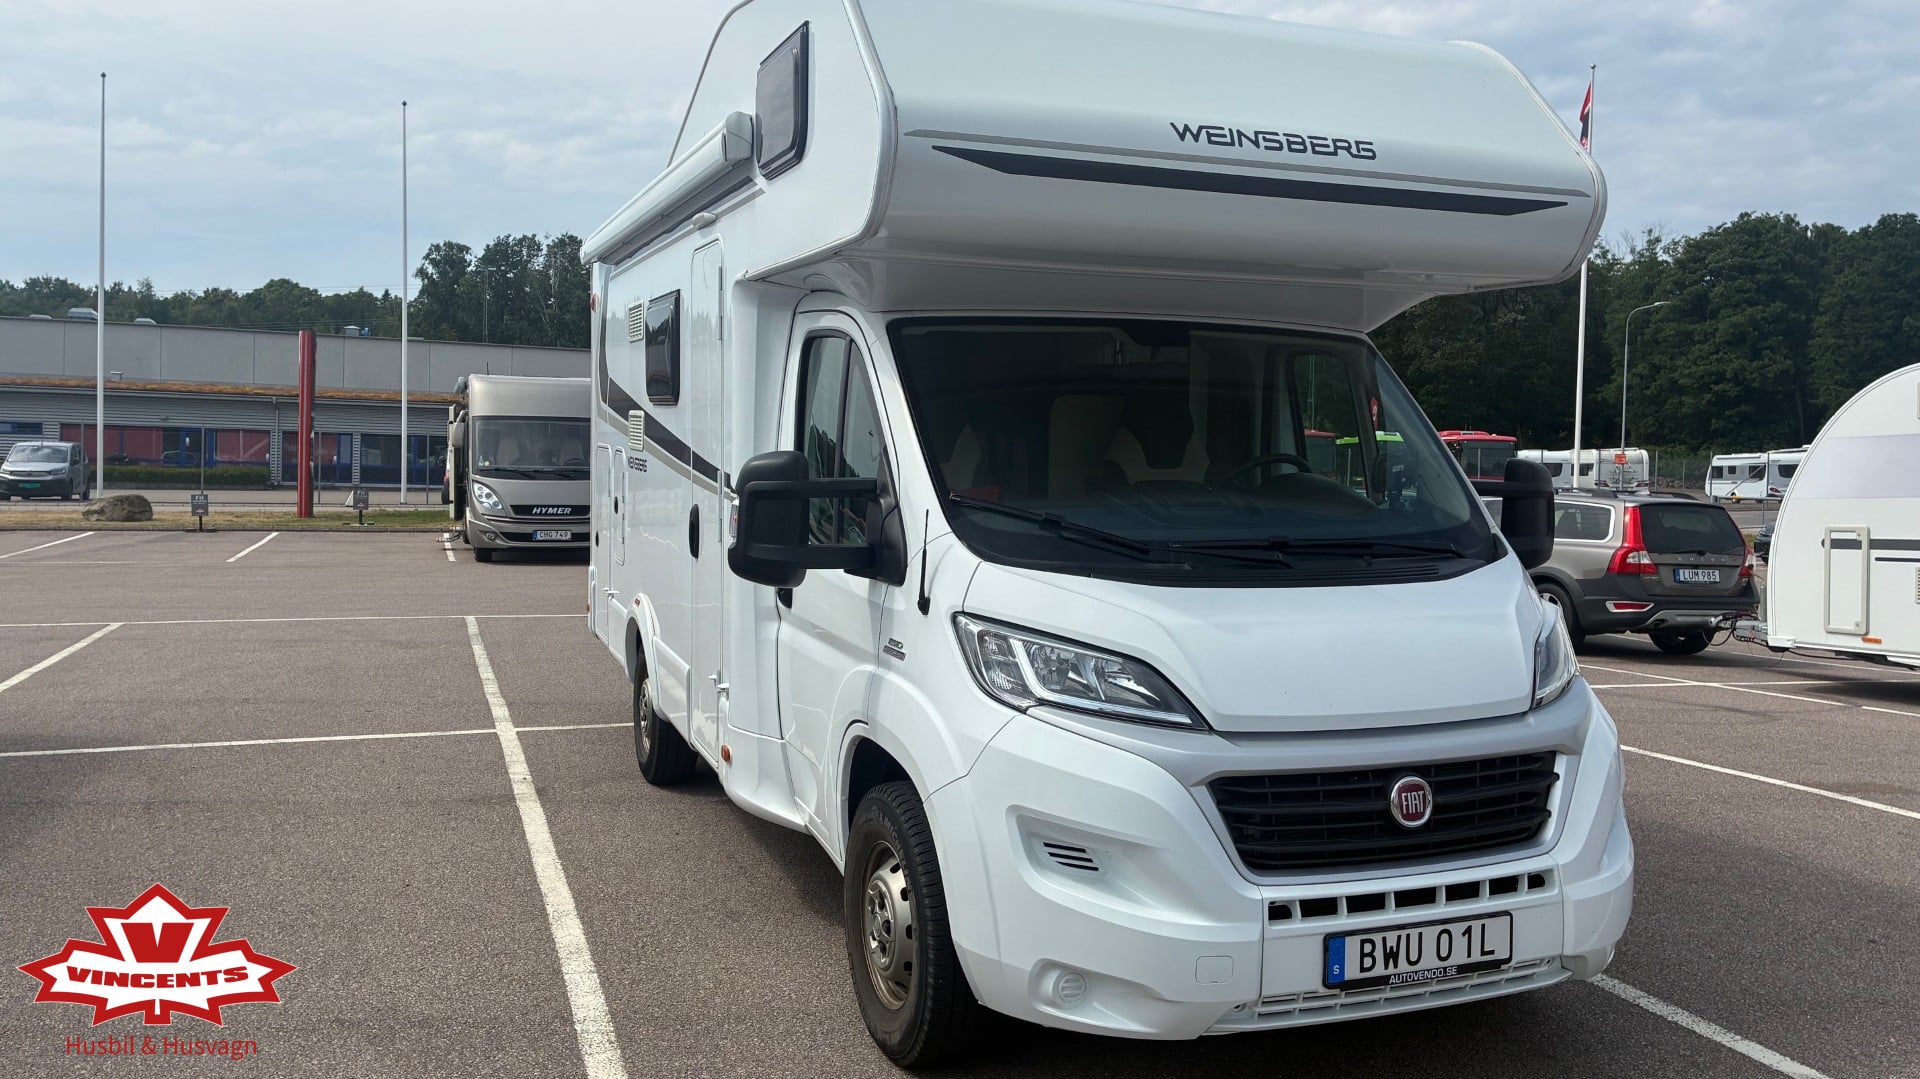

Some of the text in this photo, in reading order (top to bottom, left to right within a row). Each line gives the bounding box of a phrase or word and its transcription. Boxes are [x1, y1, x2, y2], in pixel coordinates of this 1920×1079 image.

[1170, 122, 1377, 161] WEINSBERG
[532, 507, 572, 515] HYMER
[554, 531, 569, 539] 749
[1683, 570, 1717, 581] LUM 985
[1401, 790, 1425, 815] FIAT
[1359, 922, 1496, 974] BWU 01L
[1388, 966, 1458, 985] AUTOVENDO.SE
